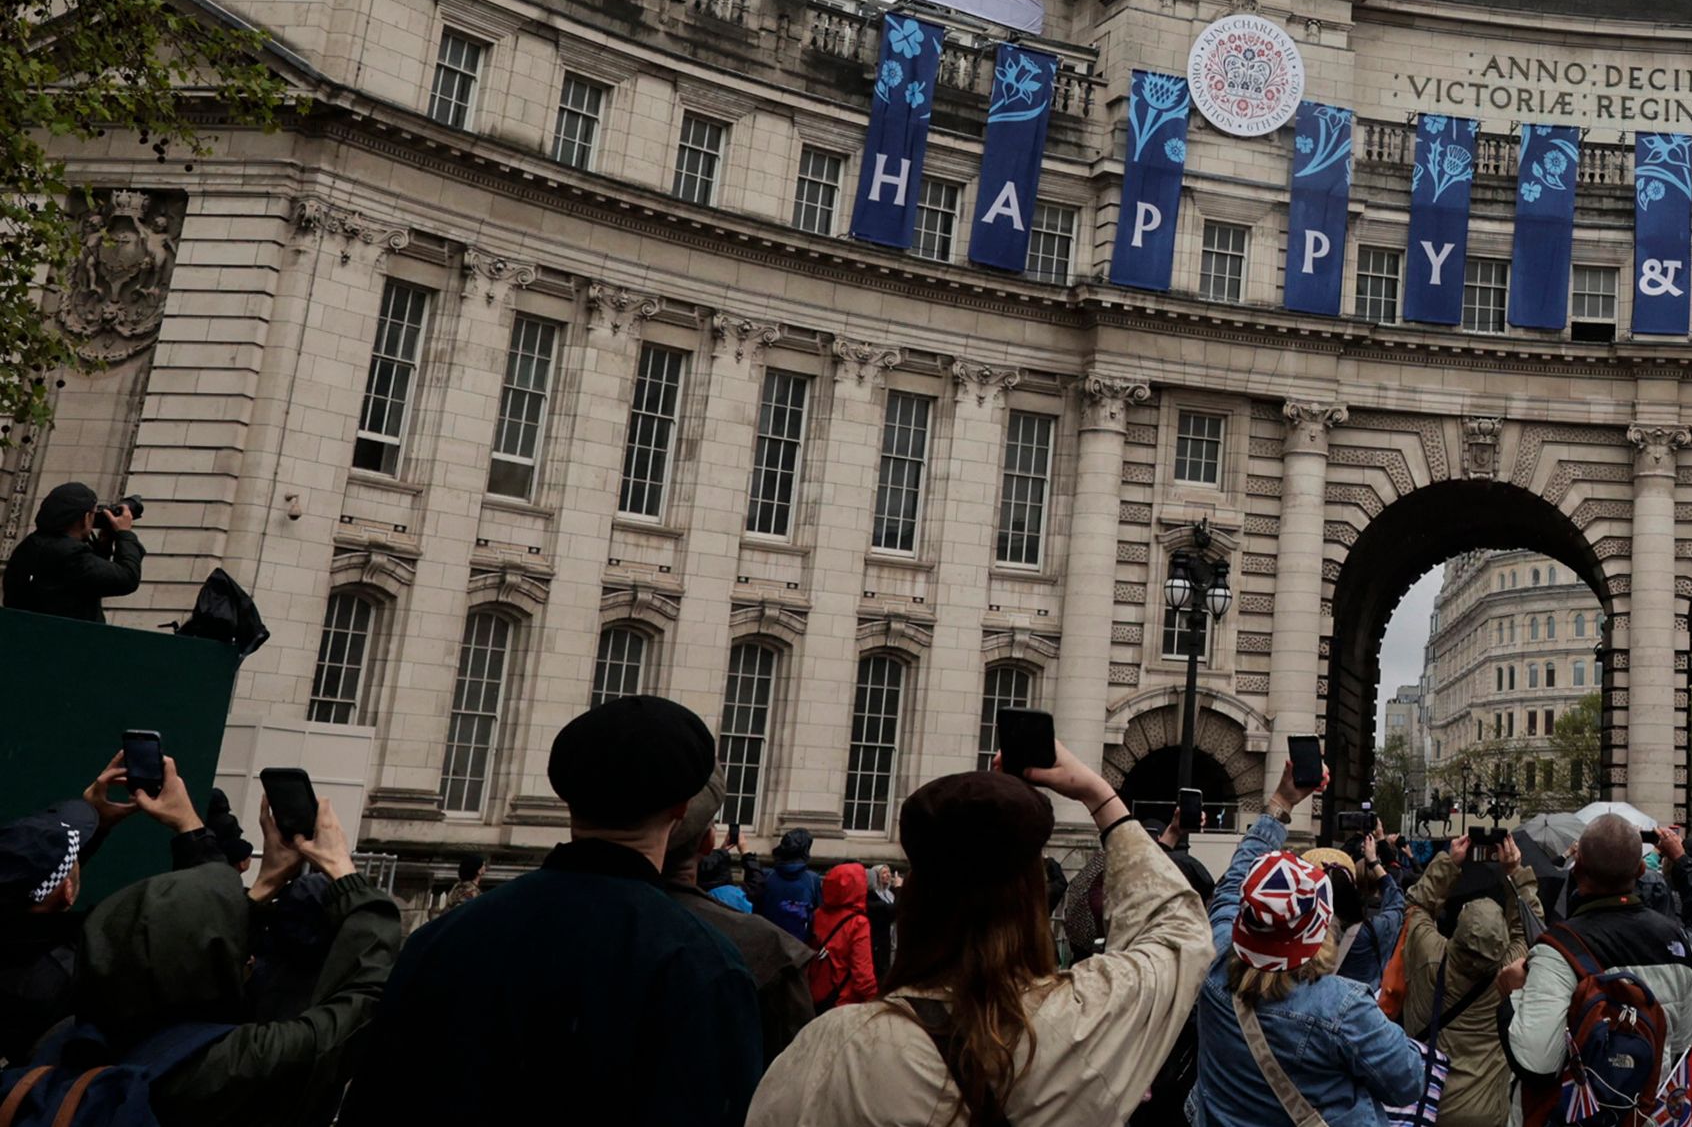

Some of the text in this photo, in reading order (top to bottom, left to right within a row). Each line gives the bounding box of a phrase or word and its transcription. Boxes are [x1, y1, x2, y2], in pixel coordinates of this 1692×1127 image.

[1203, 20, 1297, 63] KING CHARLES III
[1192, 54, 1233, 128] CORONATION
[1480, 54, 1588, 86] ANNO
[1246, 73, 1302, 133] 6TH MAY 2023
[1408, 75, 1575, 116] VICTORIÆ
[1638, 258, 1684, 298] &
